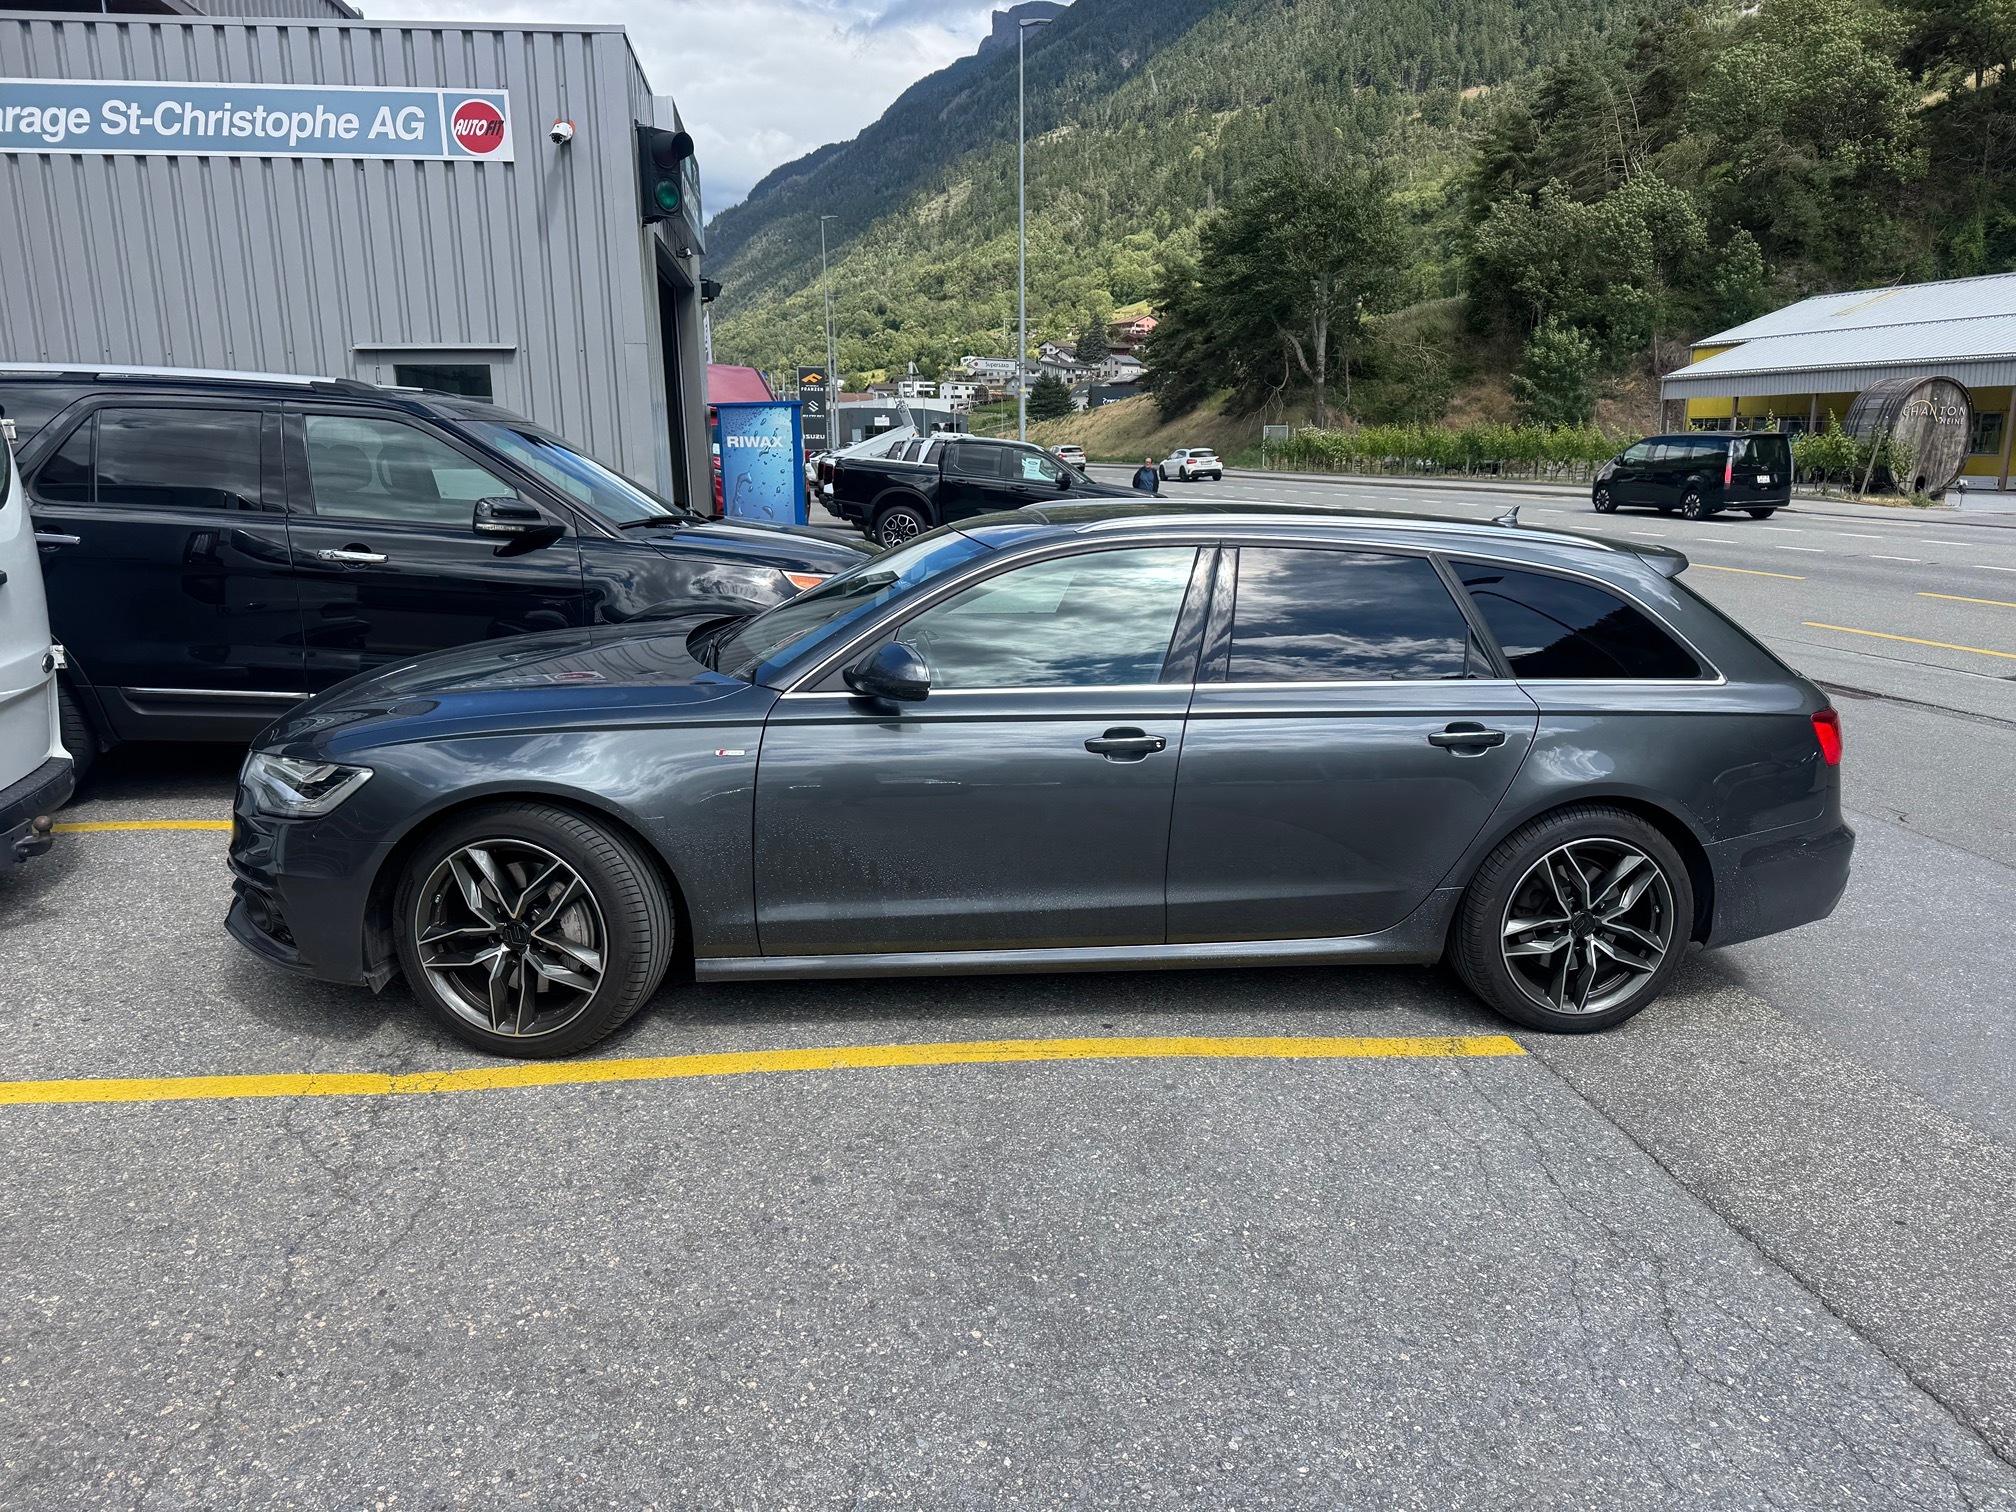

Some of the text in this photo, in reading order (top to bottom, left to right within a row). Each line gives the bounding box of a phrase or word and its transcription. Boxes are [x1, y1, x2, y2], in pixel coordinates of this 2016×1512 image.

[101, 99, 360, 146] St-Christophe
[367, 105, 425, 140] AG
[454, 118, 505, 136] AUTOFIT
[1903, 406, 1966, 416] CHANTON
[726, 436, 784, 448] RIWAX
